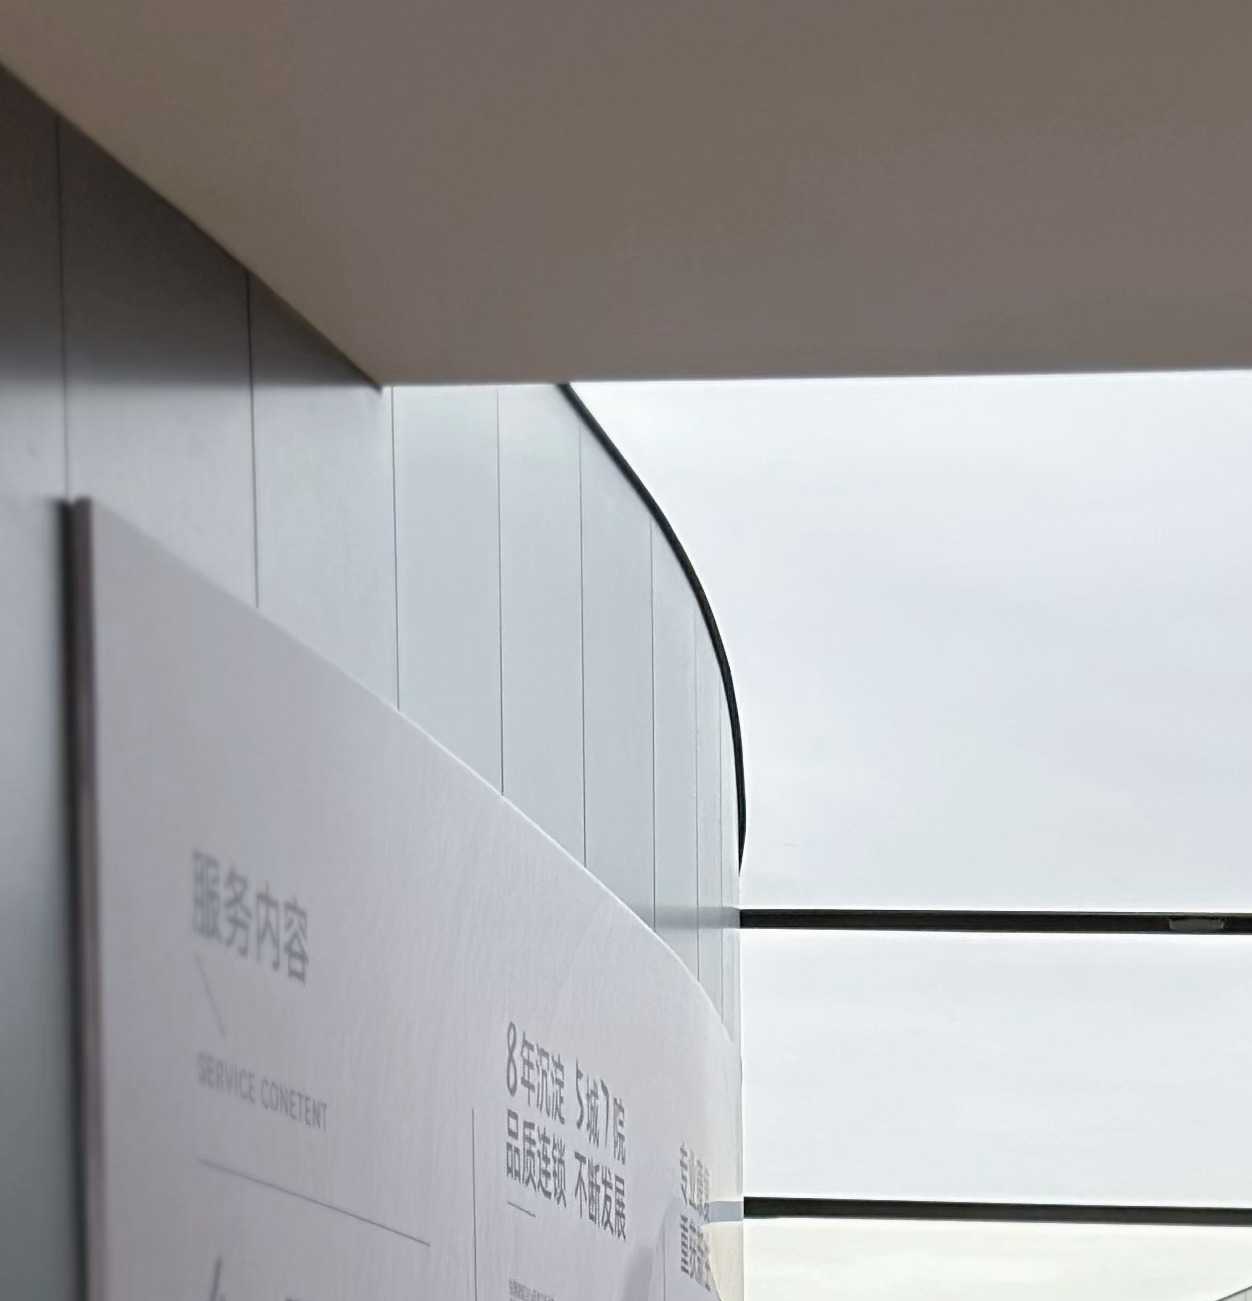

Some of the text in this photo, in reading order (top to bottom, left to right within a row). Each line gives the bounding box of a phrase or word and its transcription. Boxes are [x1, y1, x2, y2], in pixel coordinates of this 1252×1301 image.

[192, 850, 309, 987] 服务内容
[198, 1051, 256, 1104] SERVICE
[505, 1020, 566, 1125] 8年沉淀
[505, 1108, 627, 1241] 品质连锁 不断发展
